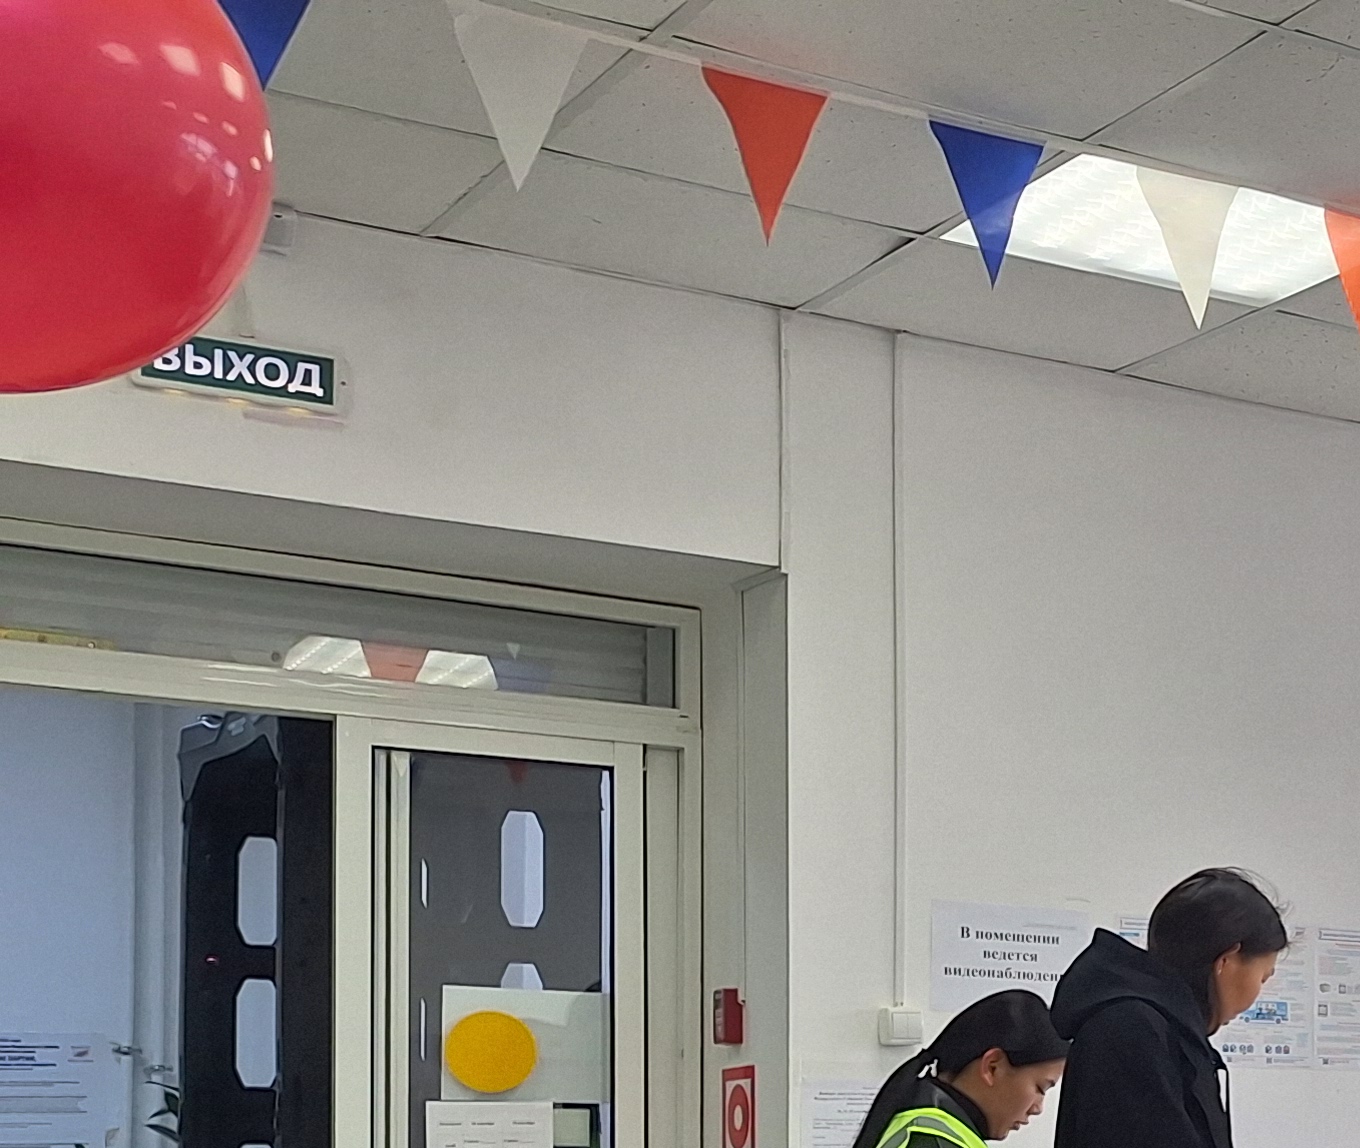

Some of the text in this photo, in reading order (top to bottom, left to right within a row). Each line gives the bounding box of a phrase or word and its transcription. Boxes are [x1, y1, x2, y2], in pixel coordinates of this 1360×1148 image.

[153, 343, 324, 397] ВЫХОД
[960, 926, 1060, 945] В помещении
[983, 950, 1038, 962] ведется
[944, 966, 1061, 982] видеонаблюден
